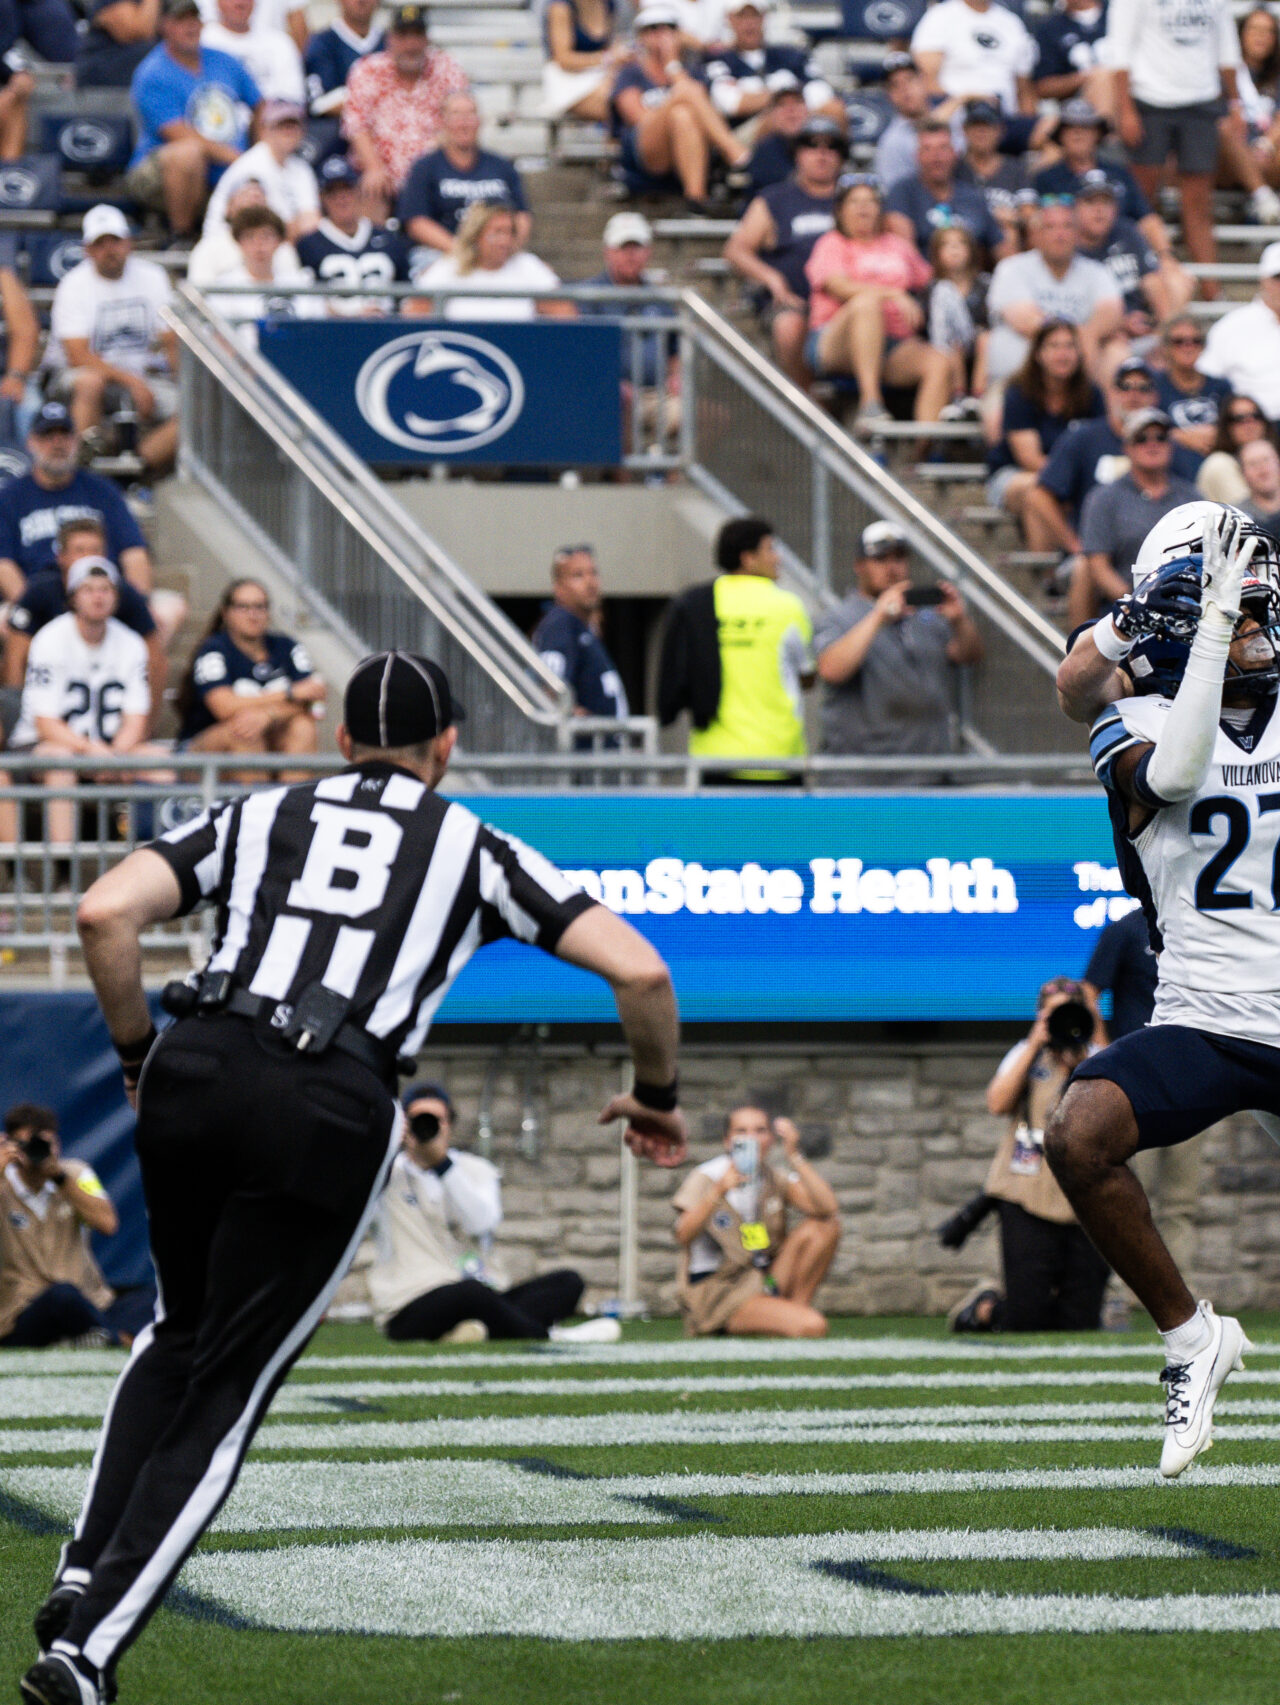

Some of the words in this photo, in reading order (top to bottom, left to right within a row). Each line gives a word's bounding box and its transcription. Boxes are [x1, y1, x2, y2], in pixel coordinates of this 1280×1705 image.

[62, 680, 125, 746] 26
[286, 801, 404, 919] B
[560, 856, 803, 914] nnState
[809, 858, 1019, 914] Health
